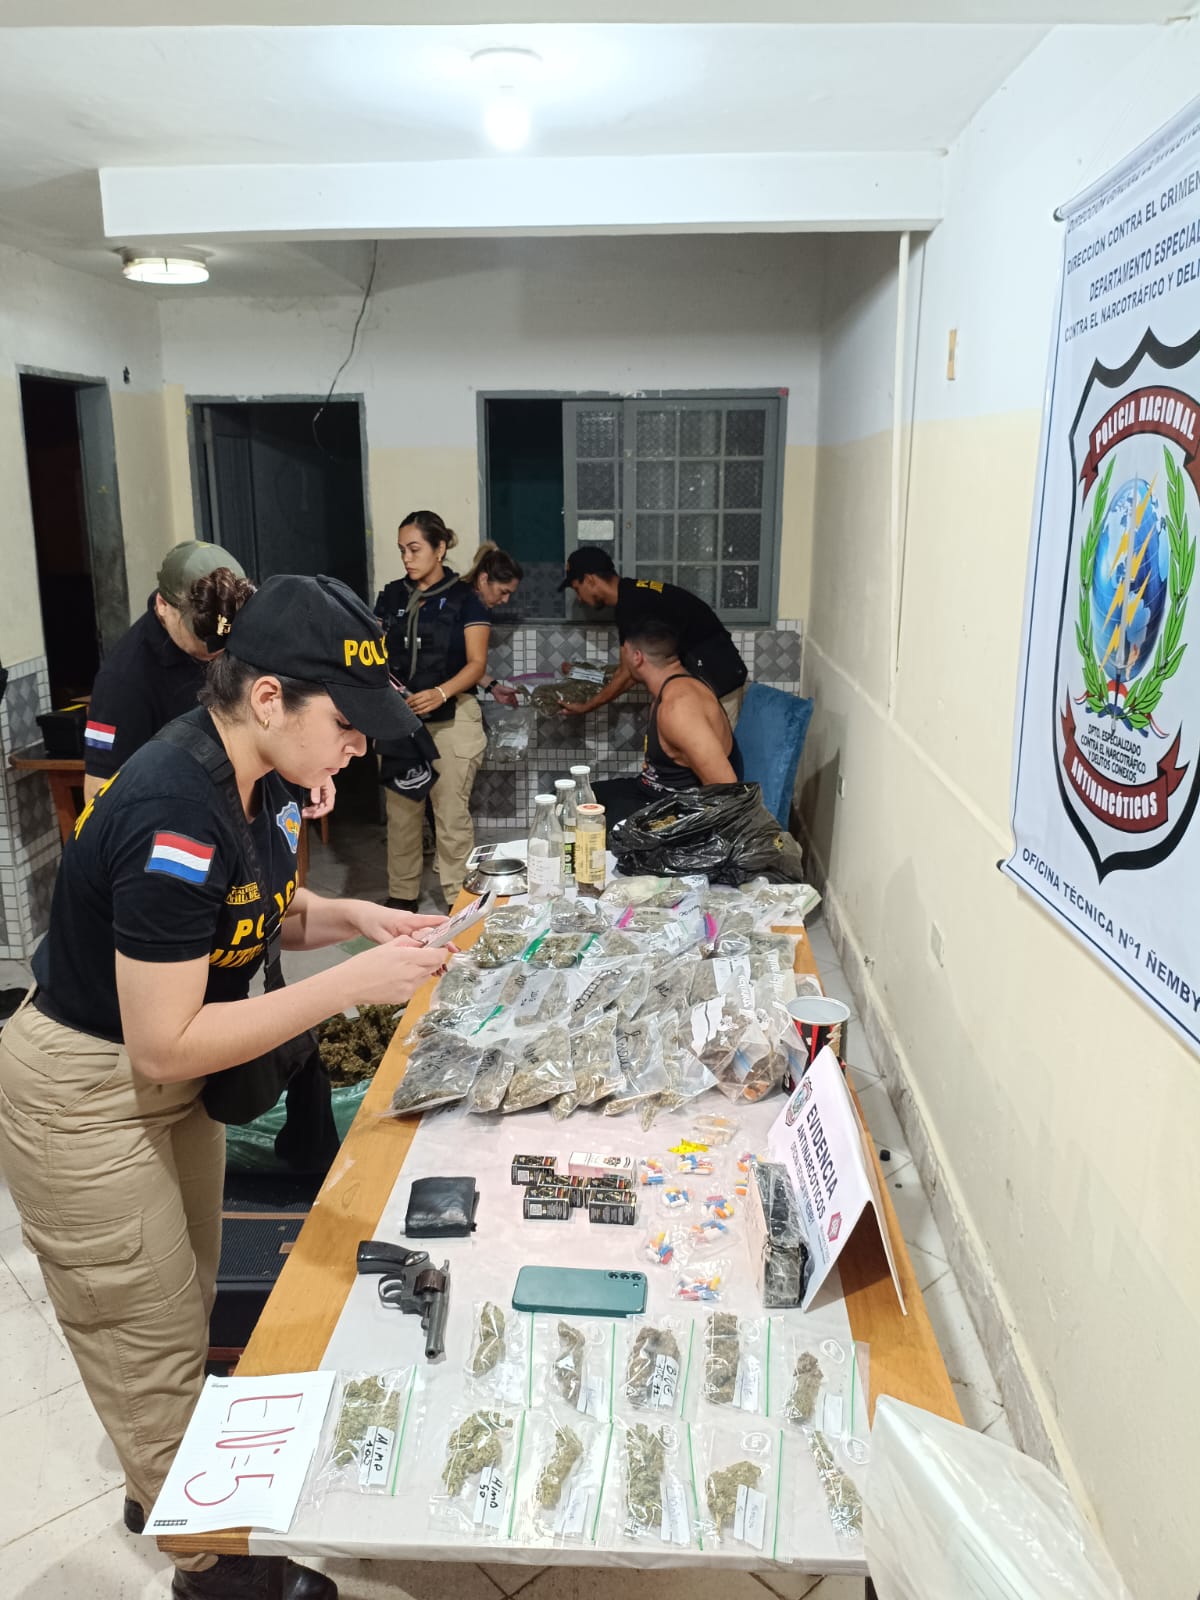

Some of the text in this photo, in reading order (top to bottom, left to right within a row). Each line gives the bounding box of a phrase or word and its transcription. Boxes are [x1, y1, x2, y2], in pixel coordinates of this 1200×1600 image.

[1107, 209, 1143, 248] CONTRA
[1145, 200, 1157, 223] EL
[1089, 247, 1152, 302] DEPARTAMENTO
[1065, 316, 1088, 342] CONTRA
[1090, 311, 1099, 329] EL
[1167, 271, 1175, 292] Y
[1095, 395, 1197, 454] POLICIA NACIONAL
[1081, 734, 1099, 753] CONTRA
[1099, 744, 1105, 755] EL
[1091, 751, 1110, 771] DELITOS
[1111, 761, 1137, 784] CONEXOS
[1101, 729, 1141, 757] ESPECIALIZADO
[1070, 756, 1158, 820] ANTINARCÓTICOS
[1022, 847, 1060, 892] OFICINA
[1063, 881, 1114, 938] TÉCNICA
[1145, 949, 1200, 1013] ÑEMBY
[806, 1103, 838, 1200] EVIDENCIA
